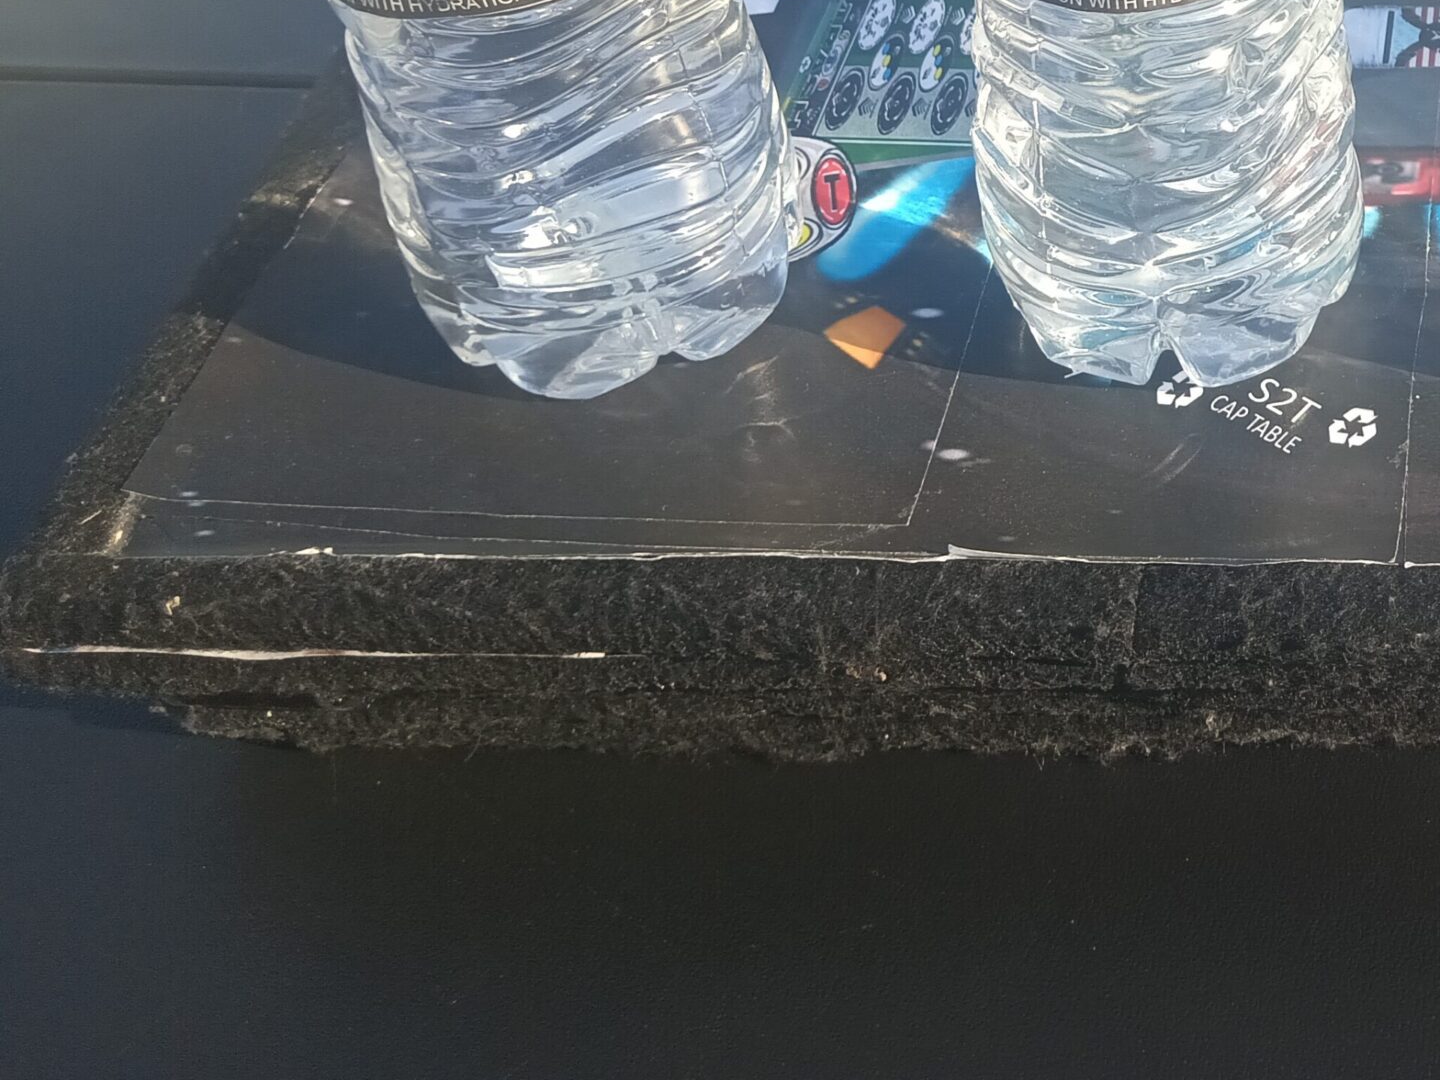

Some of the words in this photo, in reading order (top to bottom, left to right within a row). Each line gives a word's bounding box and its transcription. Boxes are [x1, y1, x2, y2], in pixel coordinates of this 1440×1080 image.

[1210, 395, 1249, 420] CAP
[1246, 413, 1302, 454] TABLE
[1248, 378, 1322, 423] S2T
